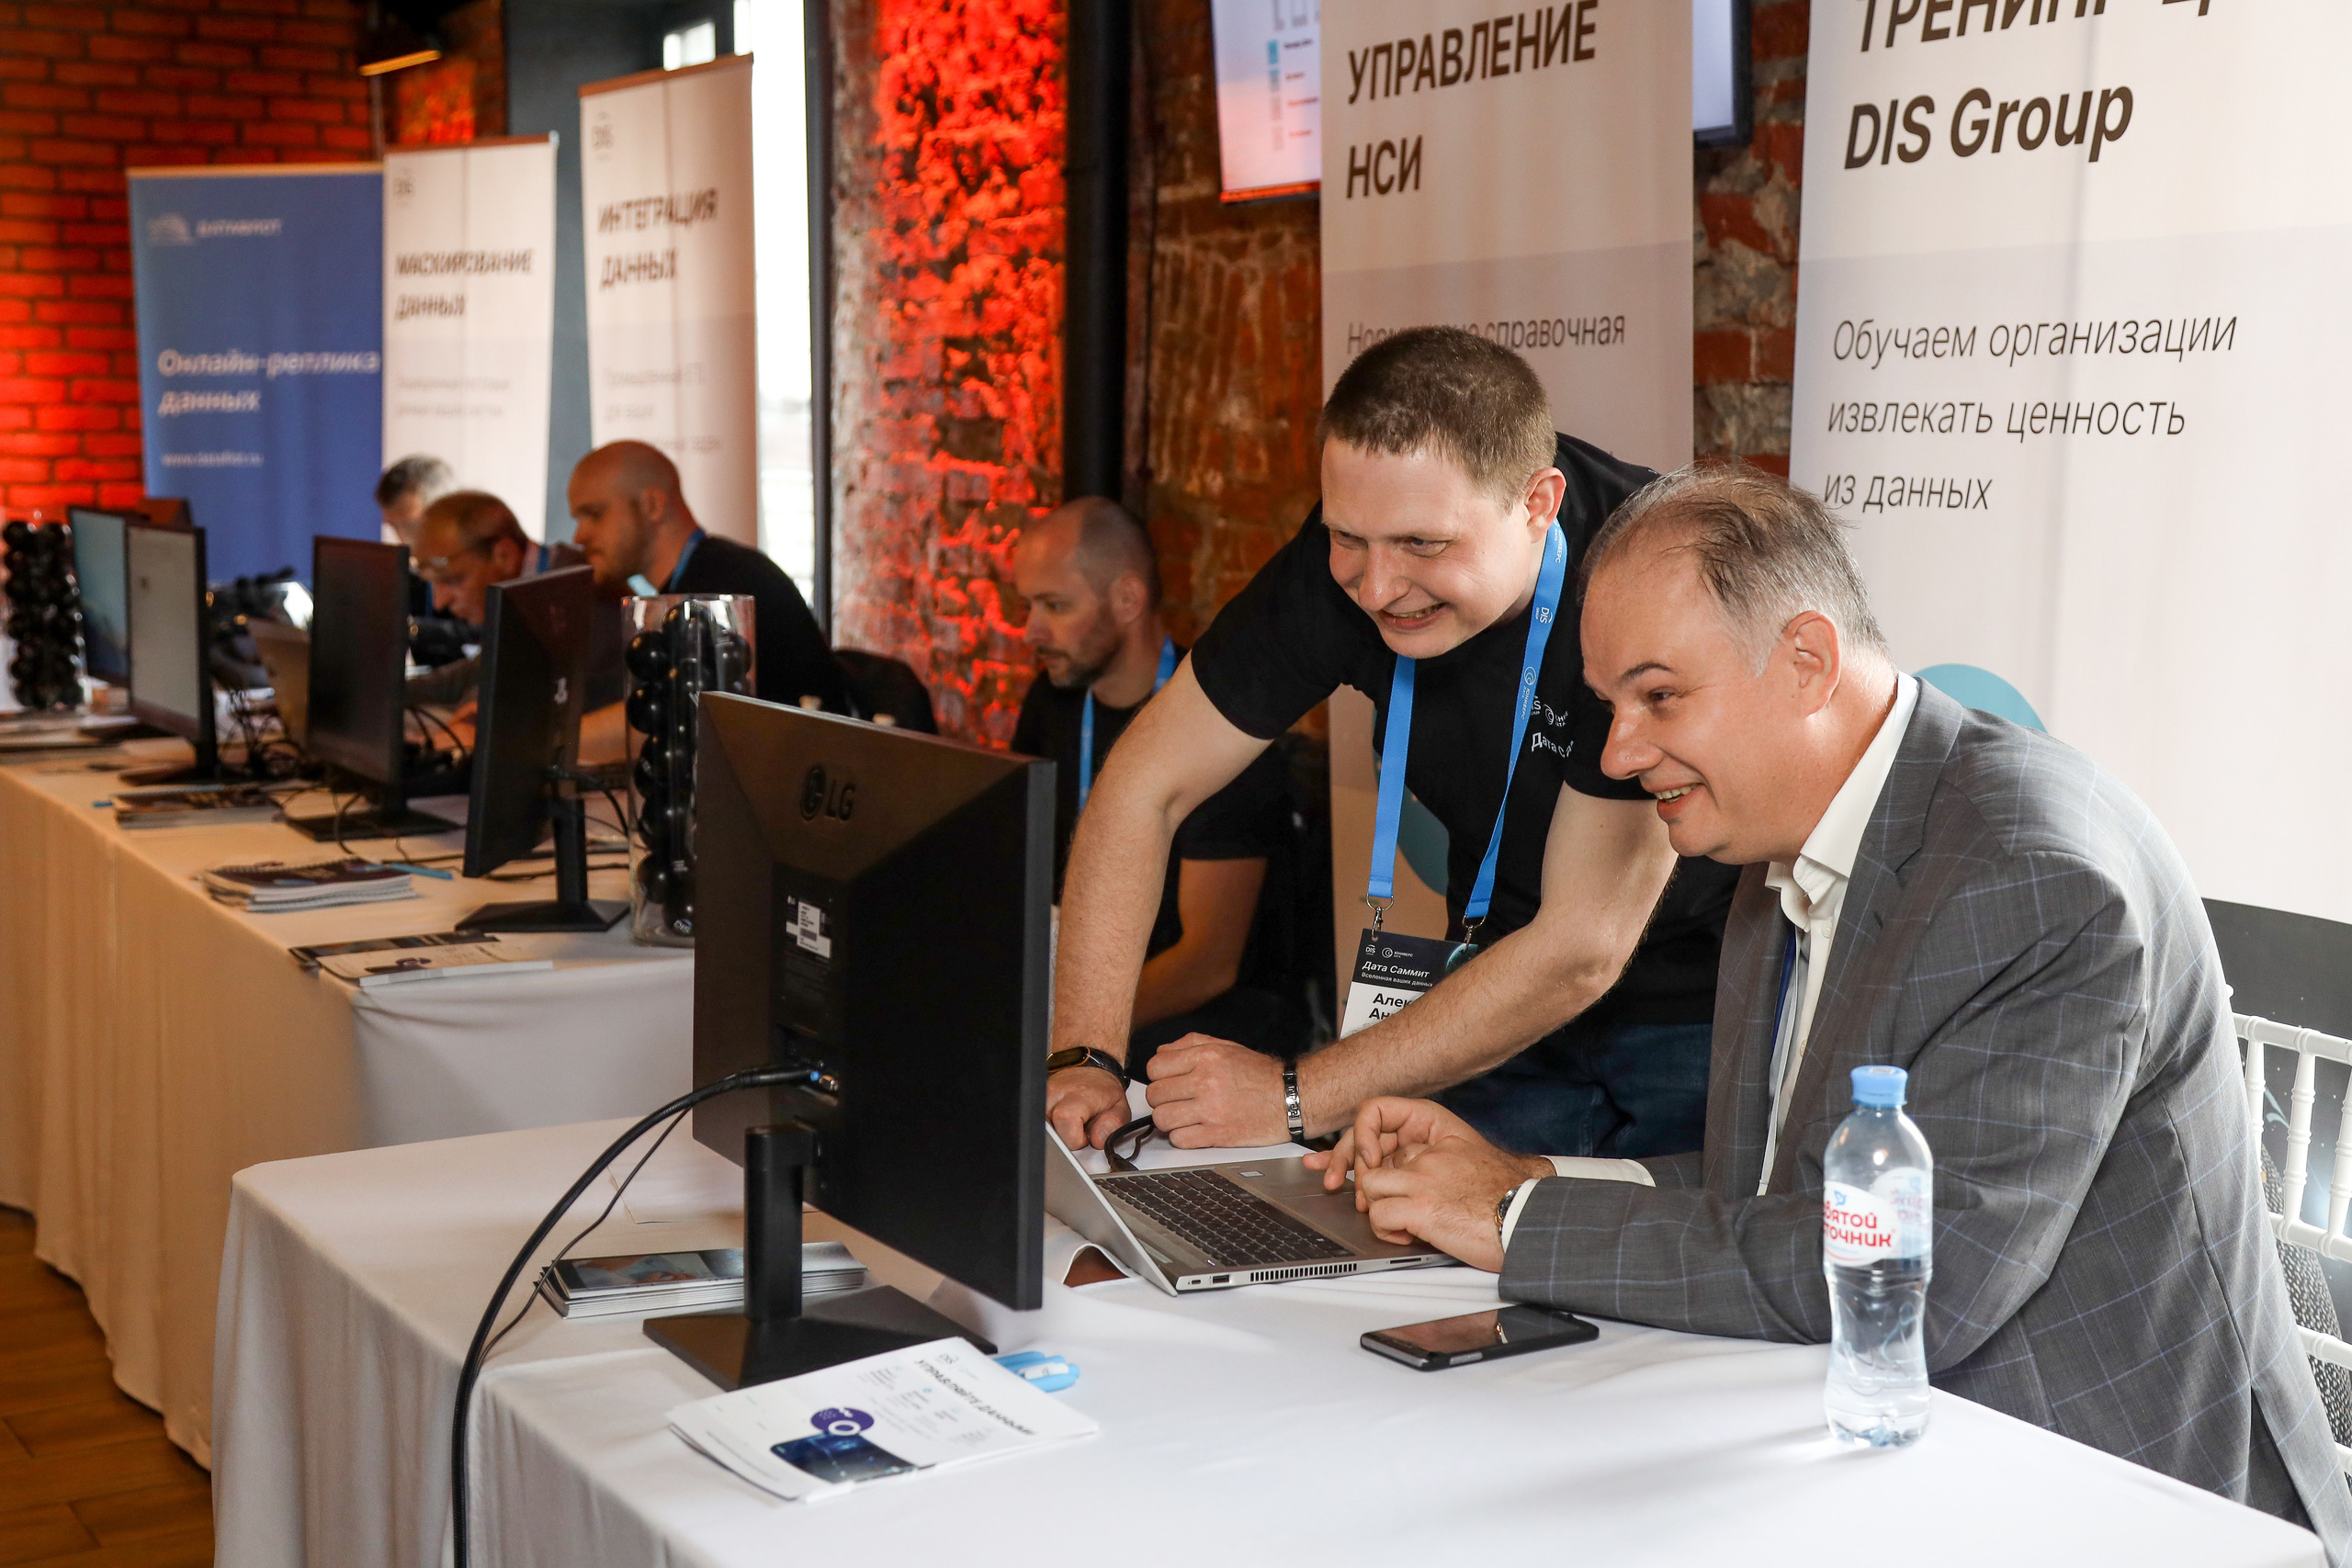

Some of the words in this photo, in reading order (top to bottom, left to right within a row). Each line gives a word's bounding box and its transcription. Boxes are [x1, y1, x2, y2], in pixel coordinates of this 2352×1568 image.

[1859, 0, 2106, 52] ТРЕН
[1348, 0, 1599, 105] УПРАВЛЕНИЕ
[1844, 95, 1936, 170] DIS
[1950, 85, 2134, 163] Group
[1346, 135, 1423, 199] НСИ
[598, 187, 718, 231] ИНТЕГРАЦИЯ
[396, 250, 533, 276] МАСКИРОВАНИЕ
[600, 249, 677, 290] ДАННЫХ
[395, 294, 466, 320] ДАННЫХ
[1832, 318, 1977, 369] Обучаем
[1988, 315, 2238, 367] организации
[158, 390, 261, 416] данных
[1826, 400, 1994, 434] извлекать
[2006, 400, 2187, 443] ценность
[1823, 473, 1856, 505] из
[1861, 473, 1994, 514] данных
[1539, 606, 1550, 624] DIS
[1531, 732, 1557, 753] Дата
[824, 779, 856, 822] LG
[1361, 972, 1392, 981] Вселенная
[1393, 976, 1411, 985] ваших
[1362, 961, 1387, 972] Дата
[1389, 965, 1430, 978] Саммит
[1824, 1201, 1877, 1229] вятой
[1824, 1222, 1893, 1247] точник
